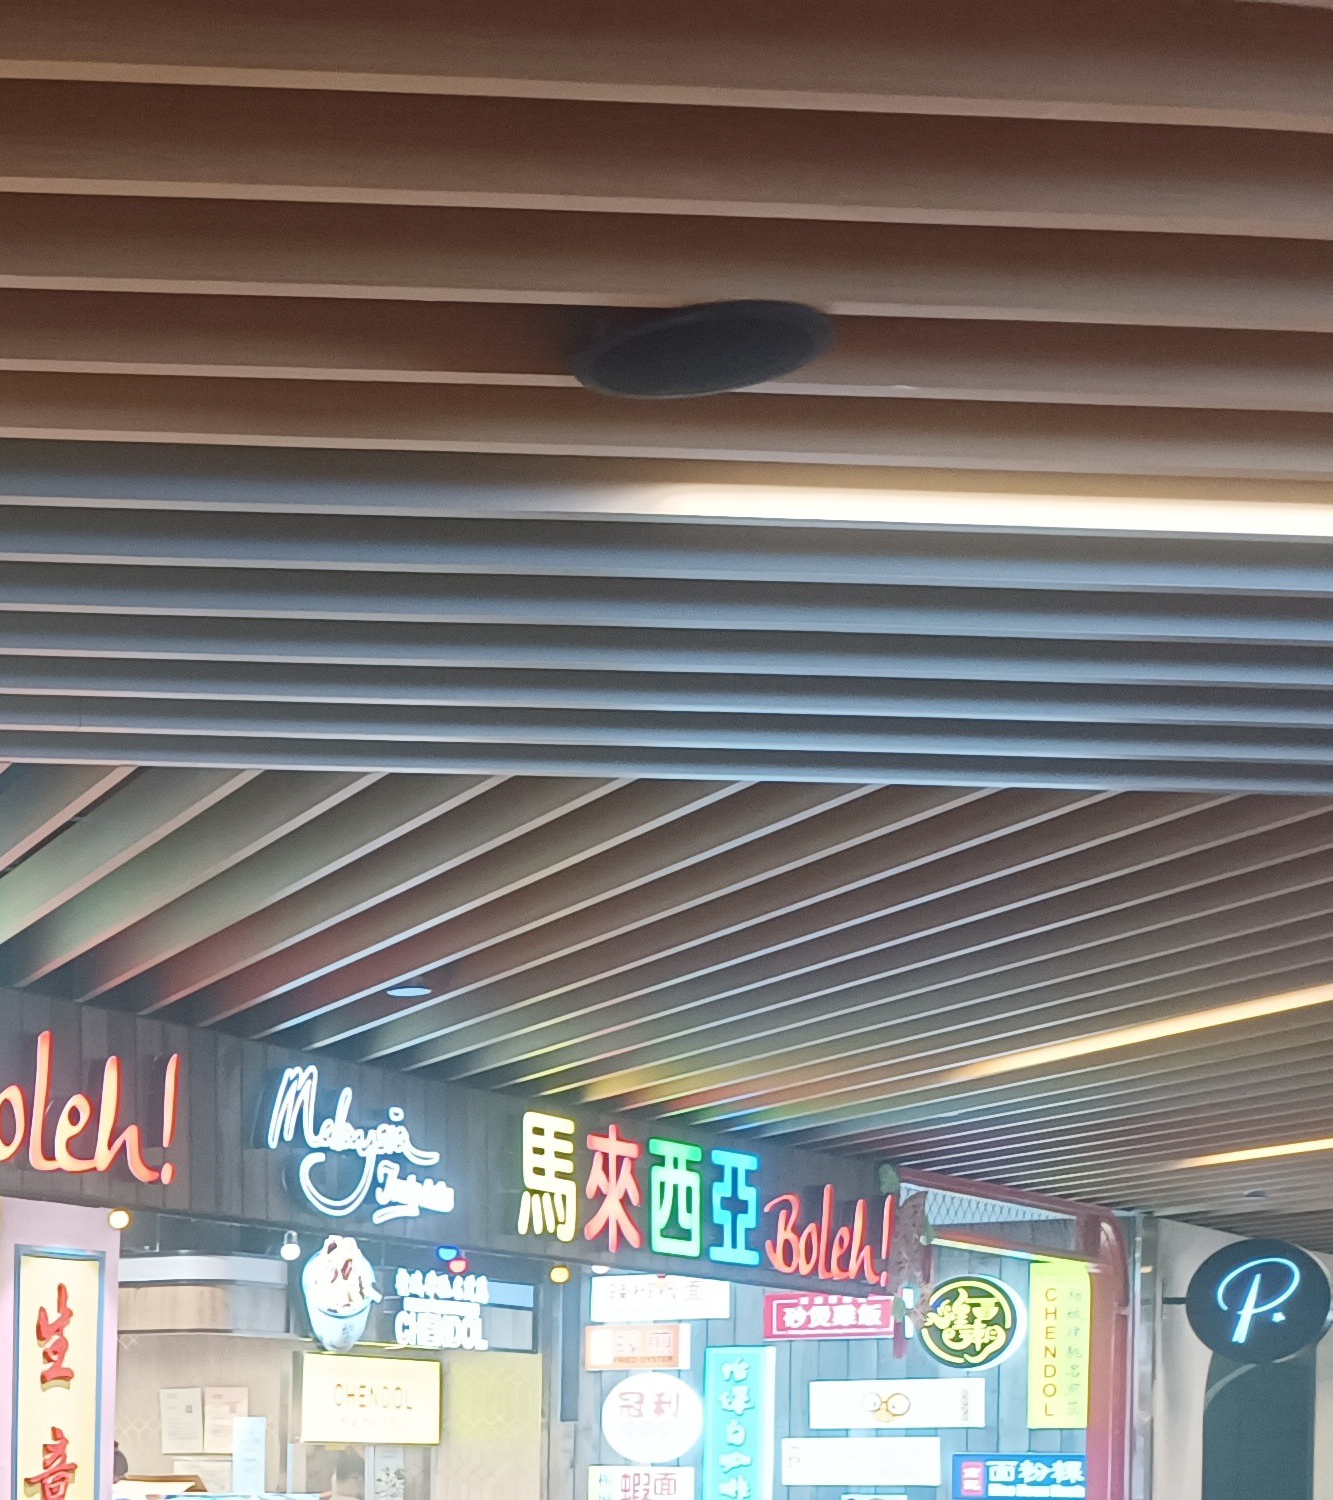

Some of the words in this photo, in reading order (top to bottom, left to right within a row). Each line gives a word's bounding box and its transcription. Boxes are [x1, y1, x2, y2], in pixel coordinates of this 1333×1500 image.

[517, 1110, 760, 1267] 馬來西亞
[763, 1183, 893, 1287] Boleh!
[394, 1310, 489, 1351] CHENDOL
[1042, 1287, 1058, 1417] CHENDOL
[333, 1383, 414, 1411] CHENDOL
